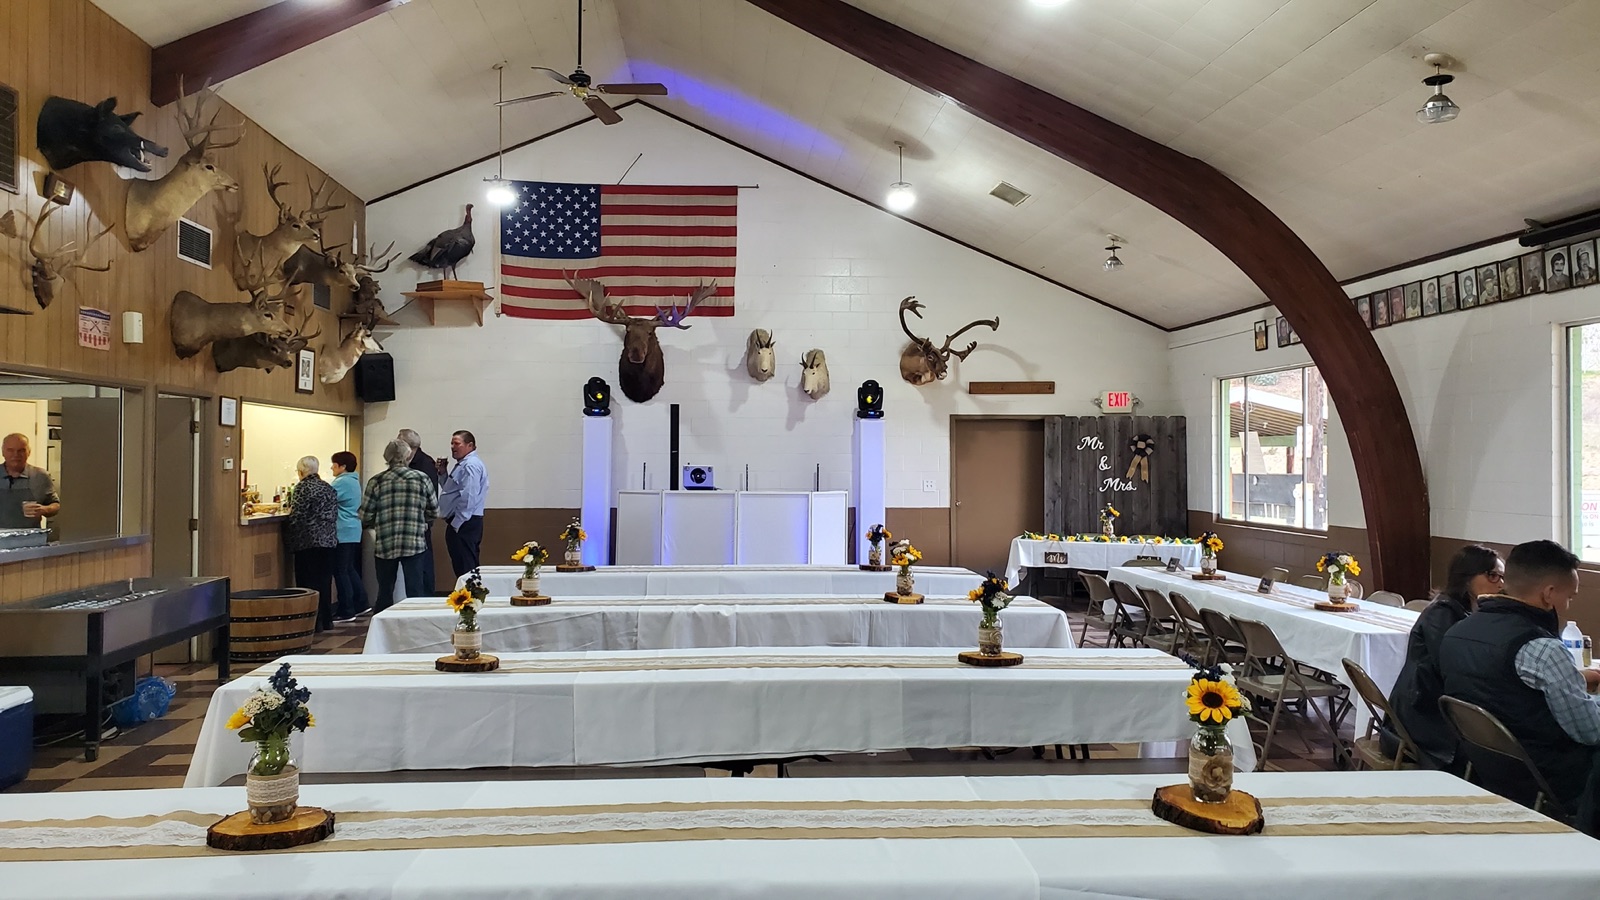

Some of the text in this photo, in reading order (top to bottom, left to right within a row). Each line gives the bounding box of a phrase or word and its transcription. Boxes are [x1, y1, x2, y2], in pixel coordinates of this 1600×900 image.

[1108, 392, 1128, 407] EXIT
[1077, 436, 1104, 450] Mr
[1099, 455, 1111, 470] &
[1099, 477, 1137, 492] Mrs
